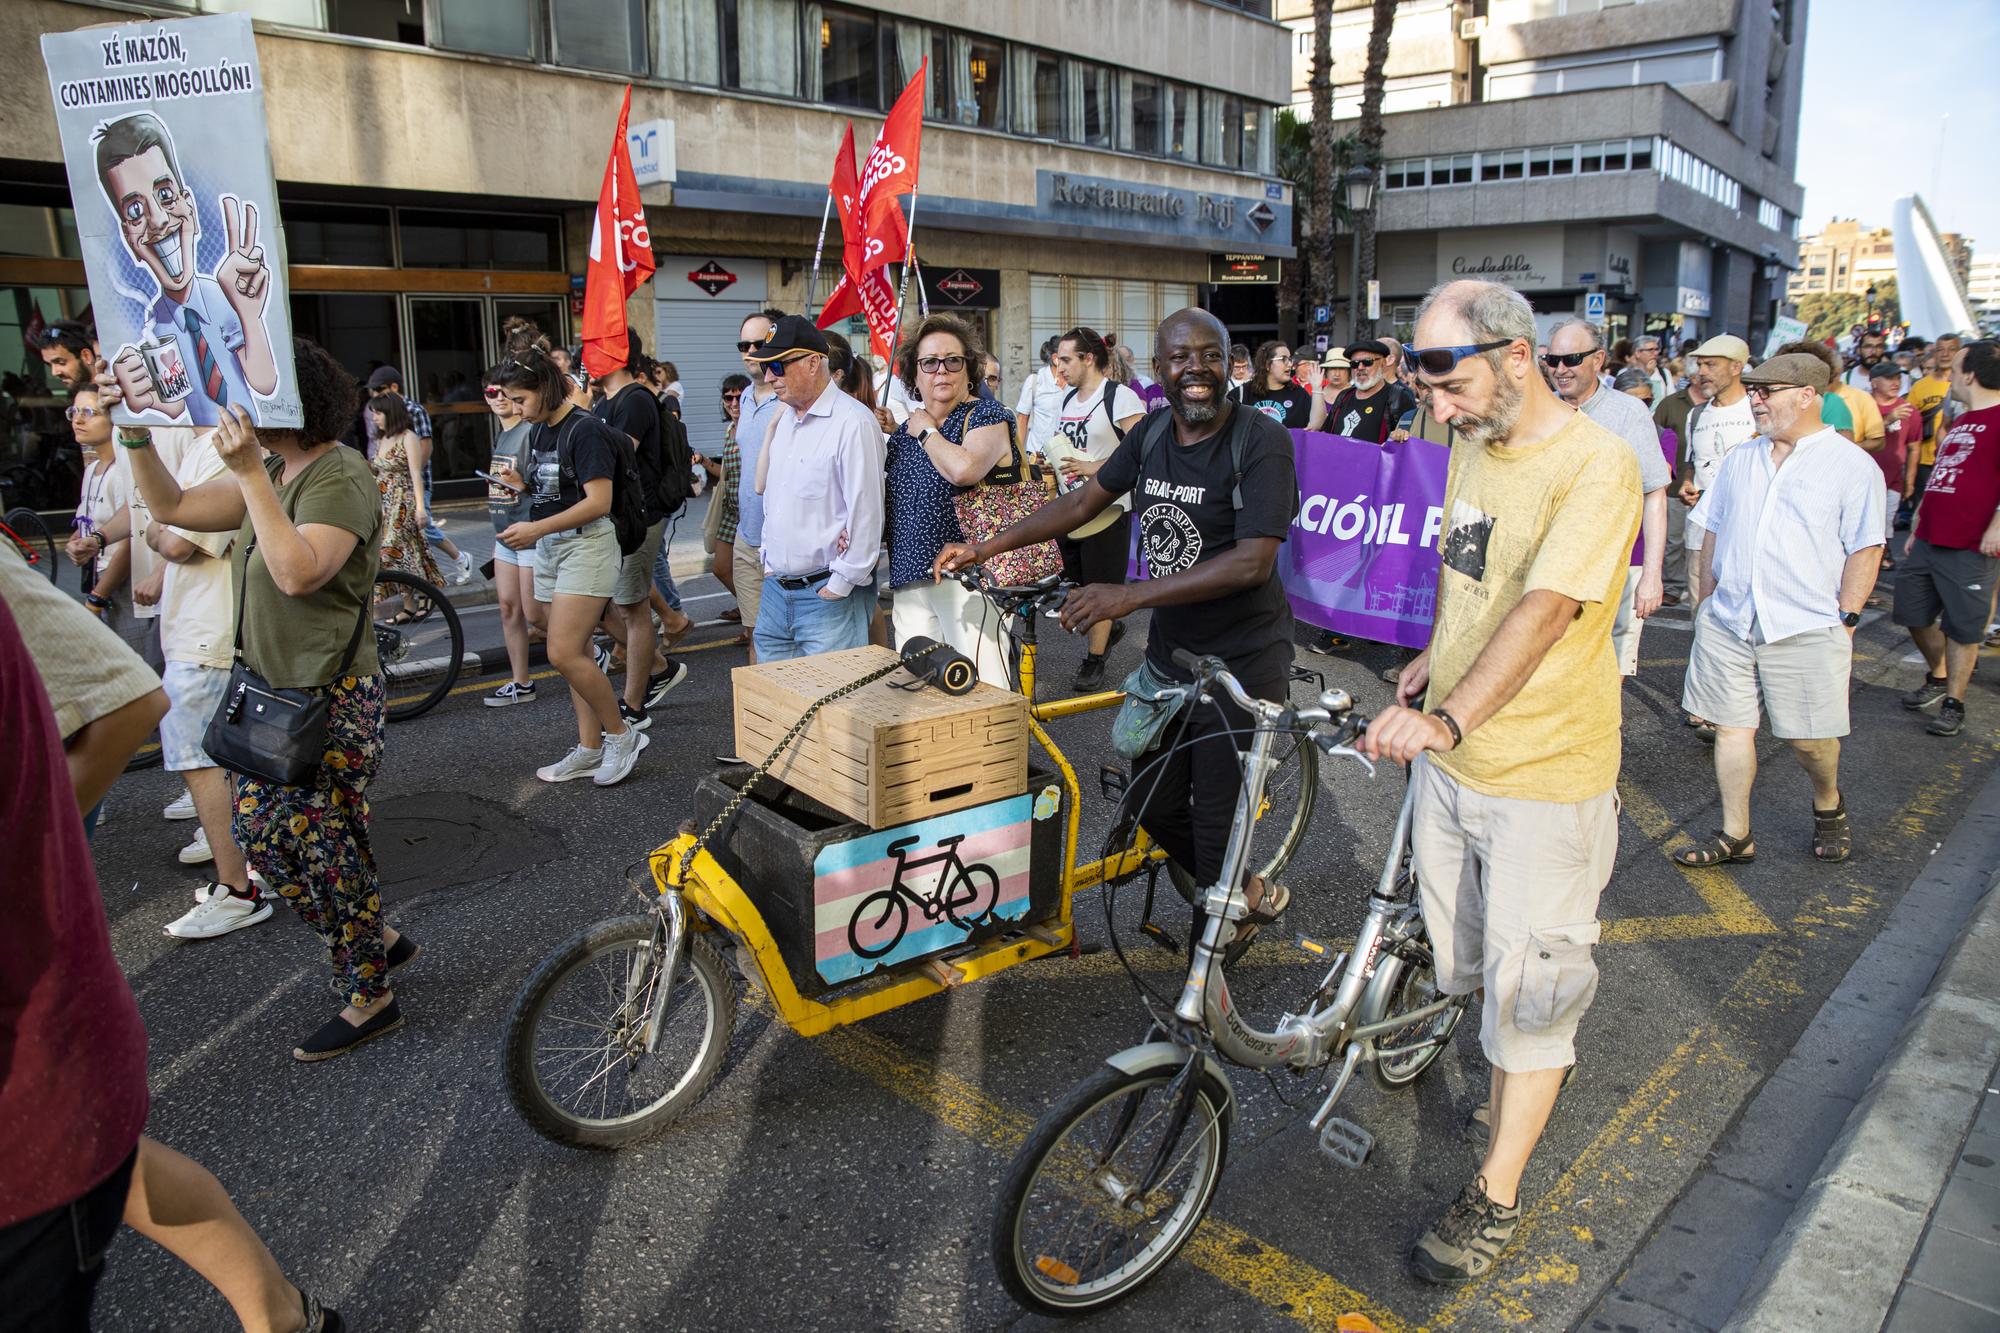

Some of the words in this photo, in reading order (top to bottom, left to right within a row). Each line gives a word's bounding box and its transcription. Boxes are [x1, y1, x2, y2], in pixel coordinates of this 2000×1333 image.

[102, 34, 121, 65] XÉ
[125, 29, 186, 63] MAZÓN,
[60, 81, 150, 107] CONTAMINES
[154, 60, 252, 98] MOGOLLÓN!
[1052, 174, 1186, 217] Restaurante
[1452, 254, 1533, 275] Ciudadela
[1146, 507, 1160, 520] NO
[1419, 505, 1444, 548] P
